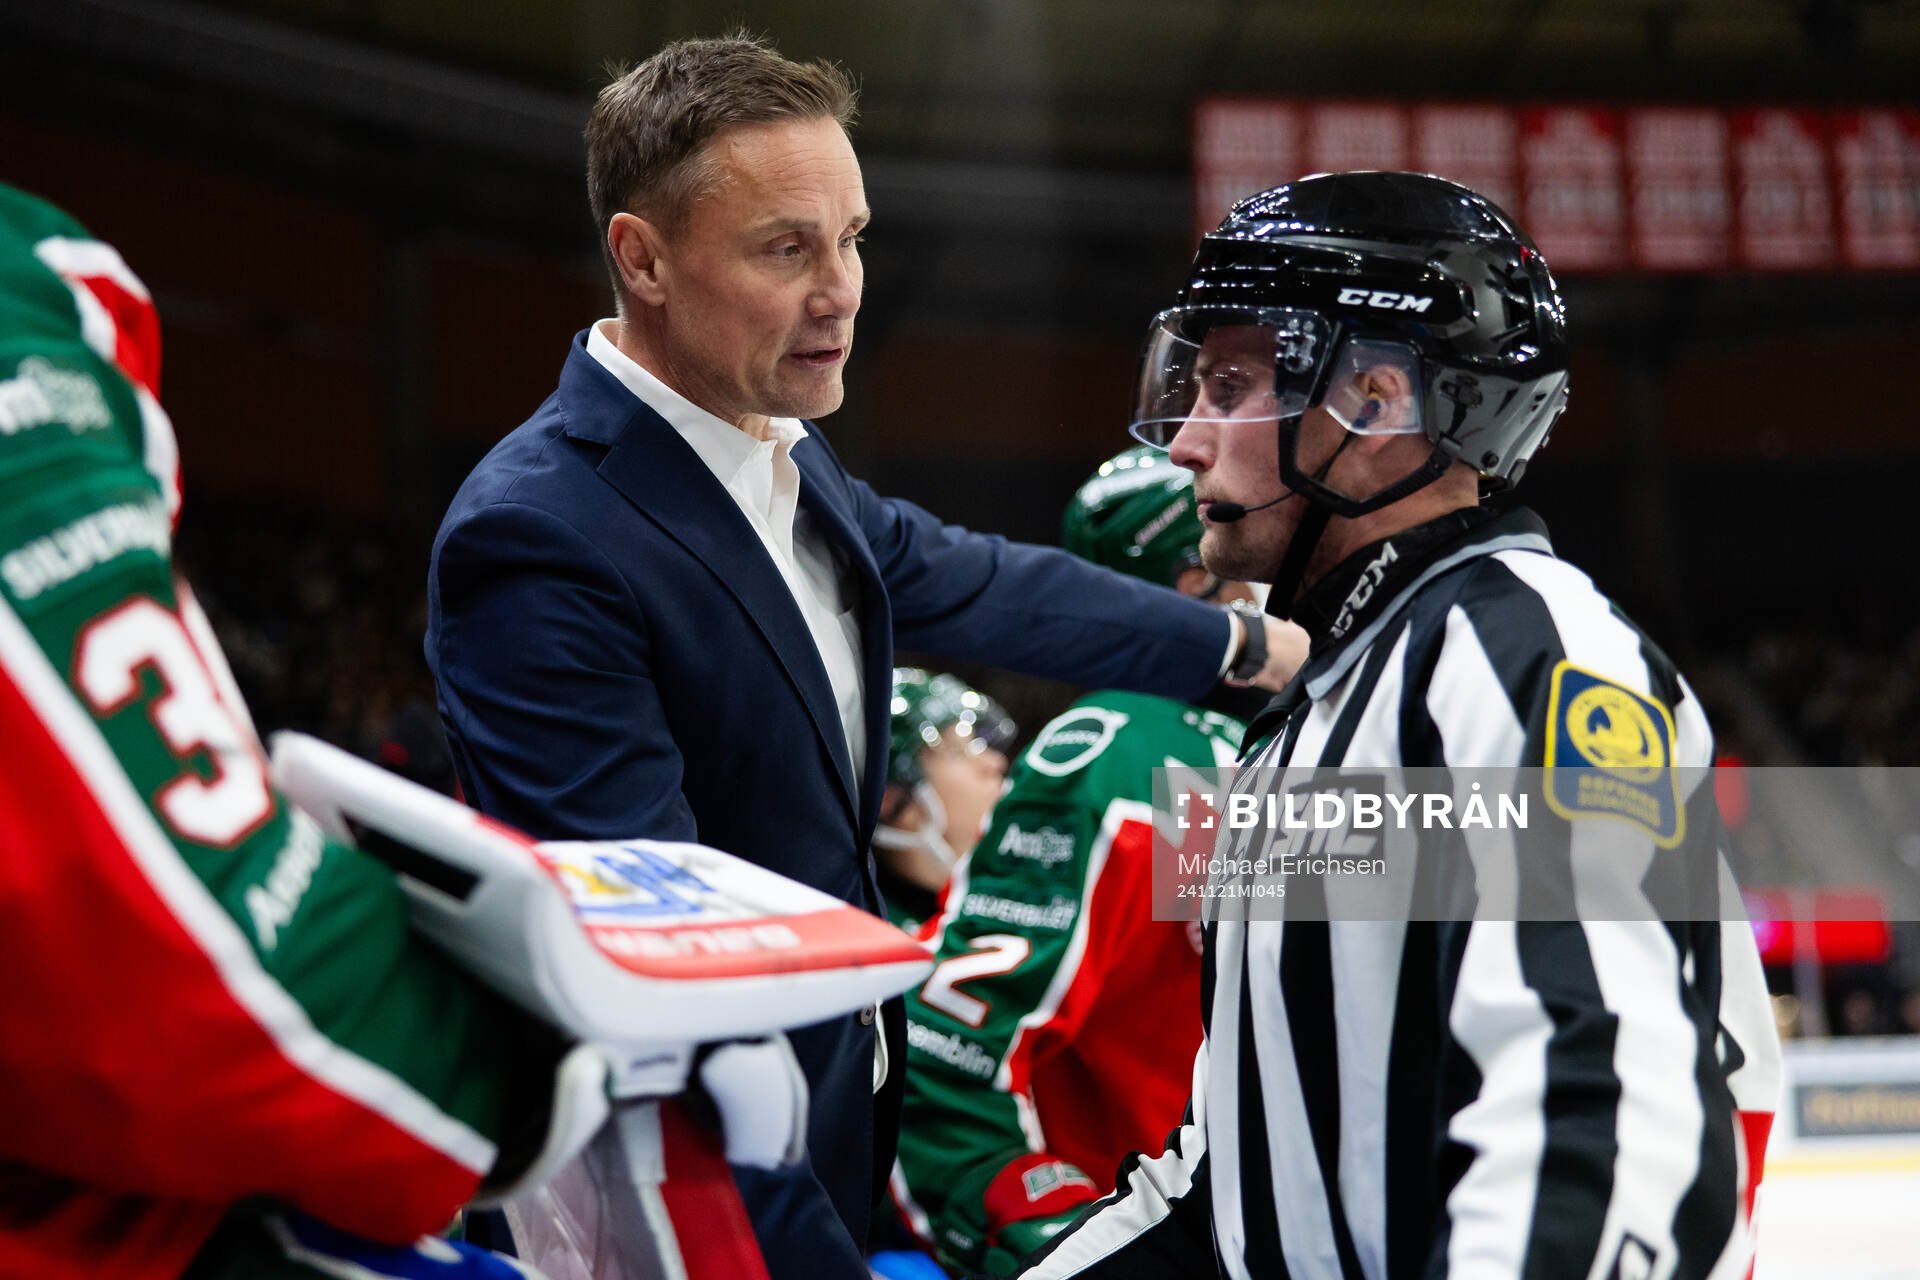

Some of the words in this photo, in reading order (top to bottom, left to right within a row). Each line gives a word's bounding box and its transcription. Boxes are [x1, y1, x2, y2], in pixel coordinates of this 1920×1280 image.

[1337, 288, 1433, 312] CCM
[1330, 542, 1398, 638] CCM
[921, 934, 1031, 1029] 2
